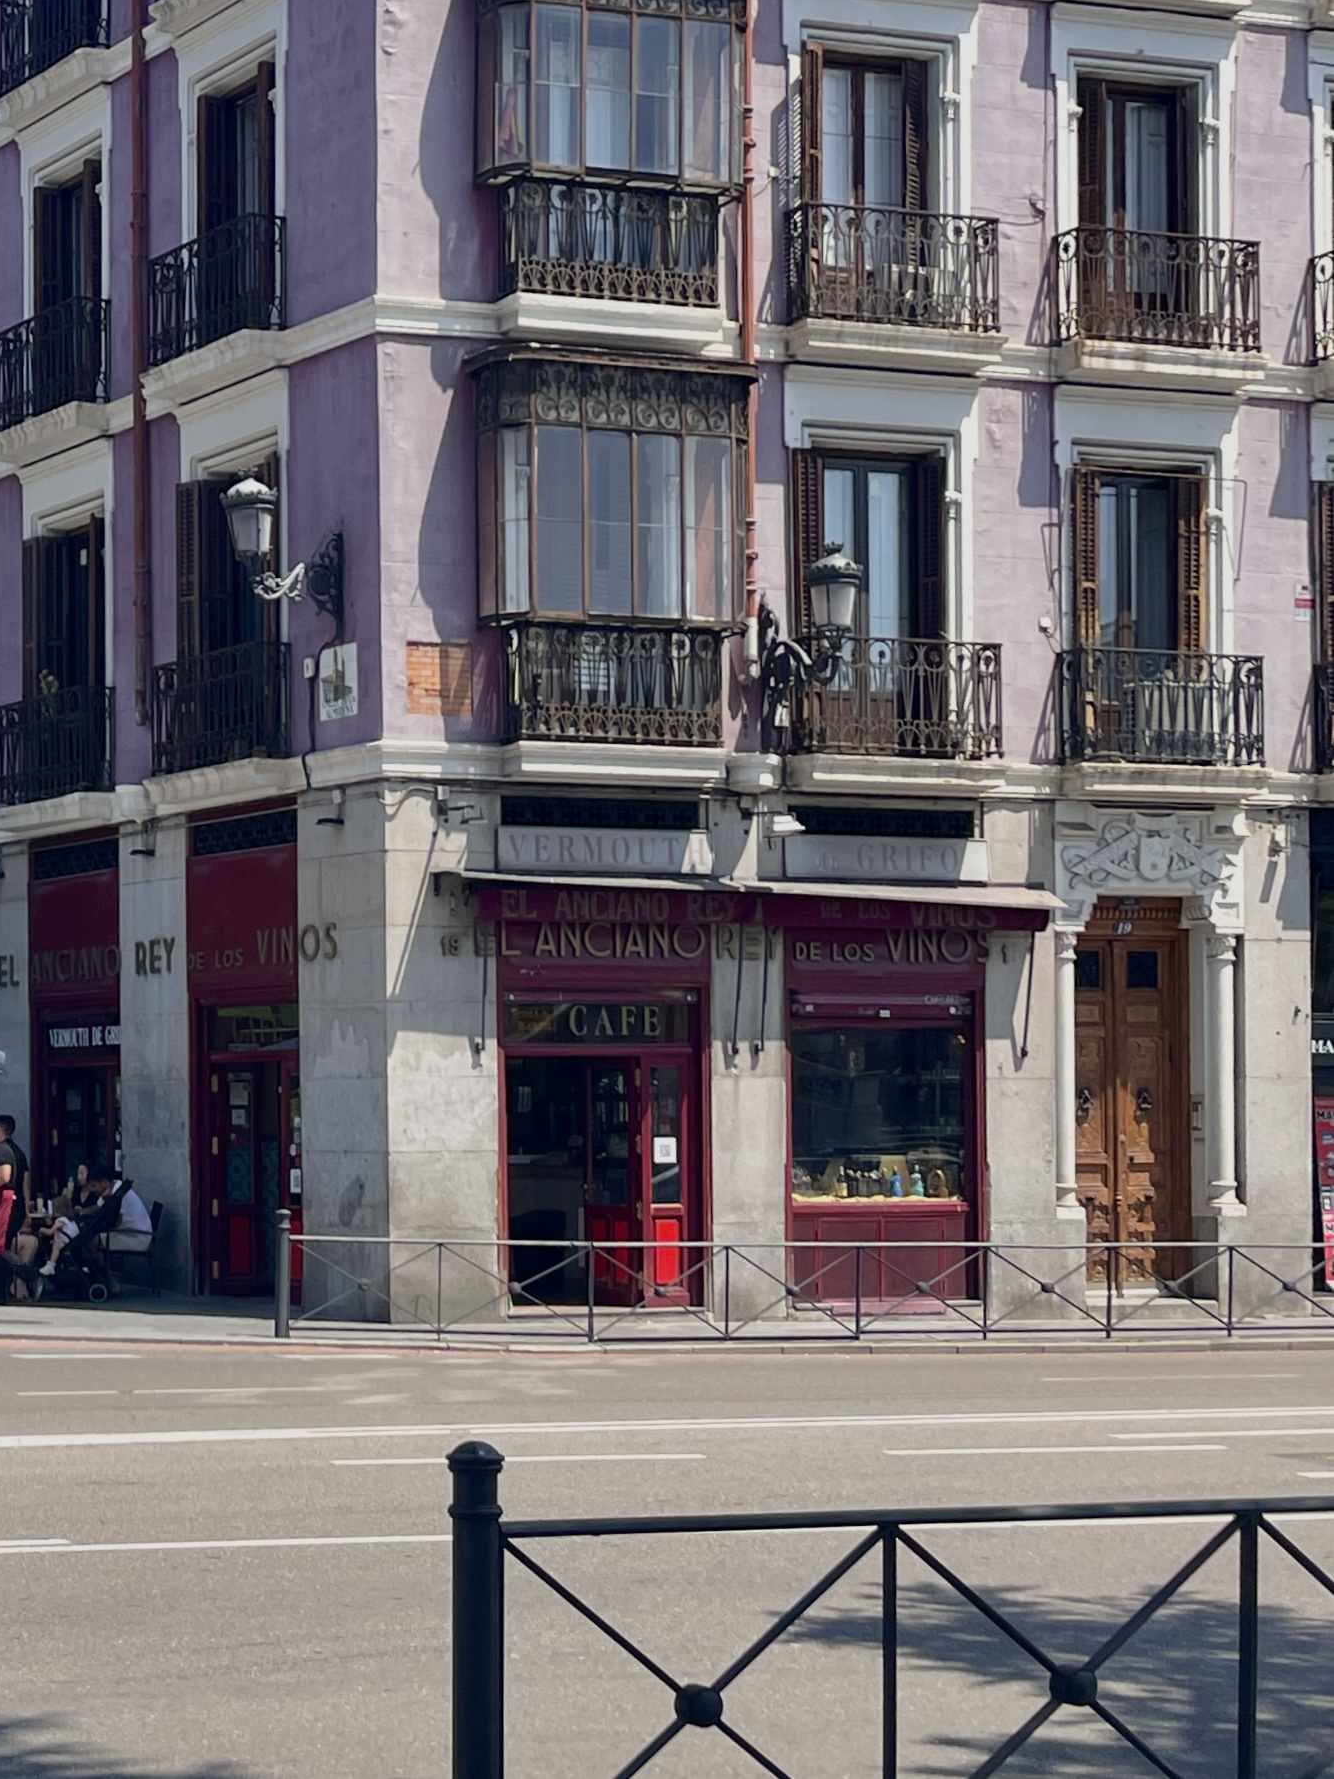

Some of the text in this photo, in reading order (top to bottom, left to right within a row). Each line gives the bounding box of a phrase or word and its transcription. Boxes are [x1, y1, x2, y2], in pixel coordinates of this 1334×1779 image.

[507, 834, 706, 866] VERMOUTH
[856, 843, 959, 873] GRIFO
[501, 890, 537, 919] EL
[554, 890, 670, 921] ANCIANO
[686, 892, 740, 922] REY
[31, 944, 122, 986] ANCIANO
[134, 936, 176, 976] REY
[214, 948, 245, 969] LOS
[256, 922, 338, 965] VINOS
[535, 921, 707, 960] ANCIANO
[795, 941, 821, 962] DE
[832, 943, 875, 963] LOS
[886, 927, 990, 965] VINOS
[568, 1004, 661, 1037] CAFE
